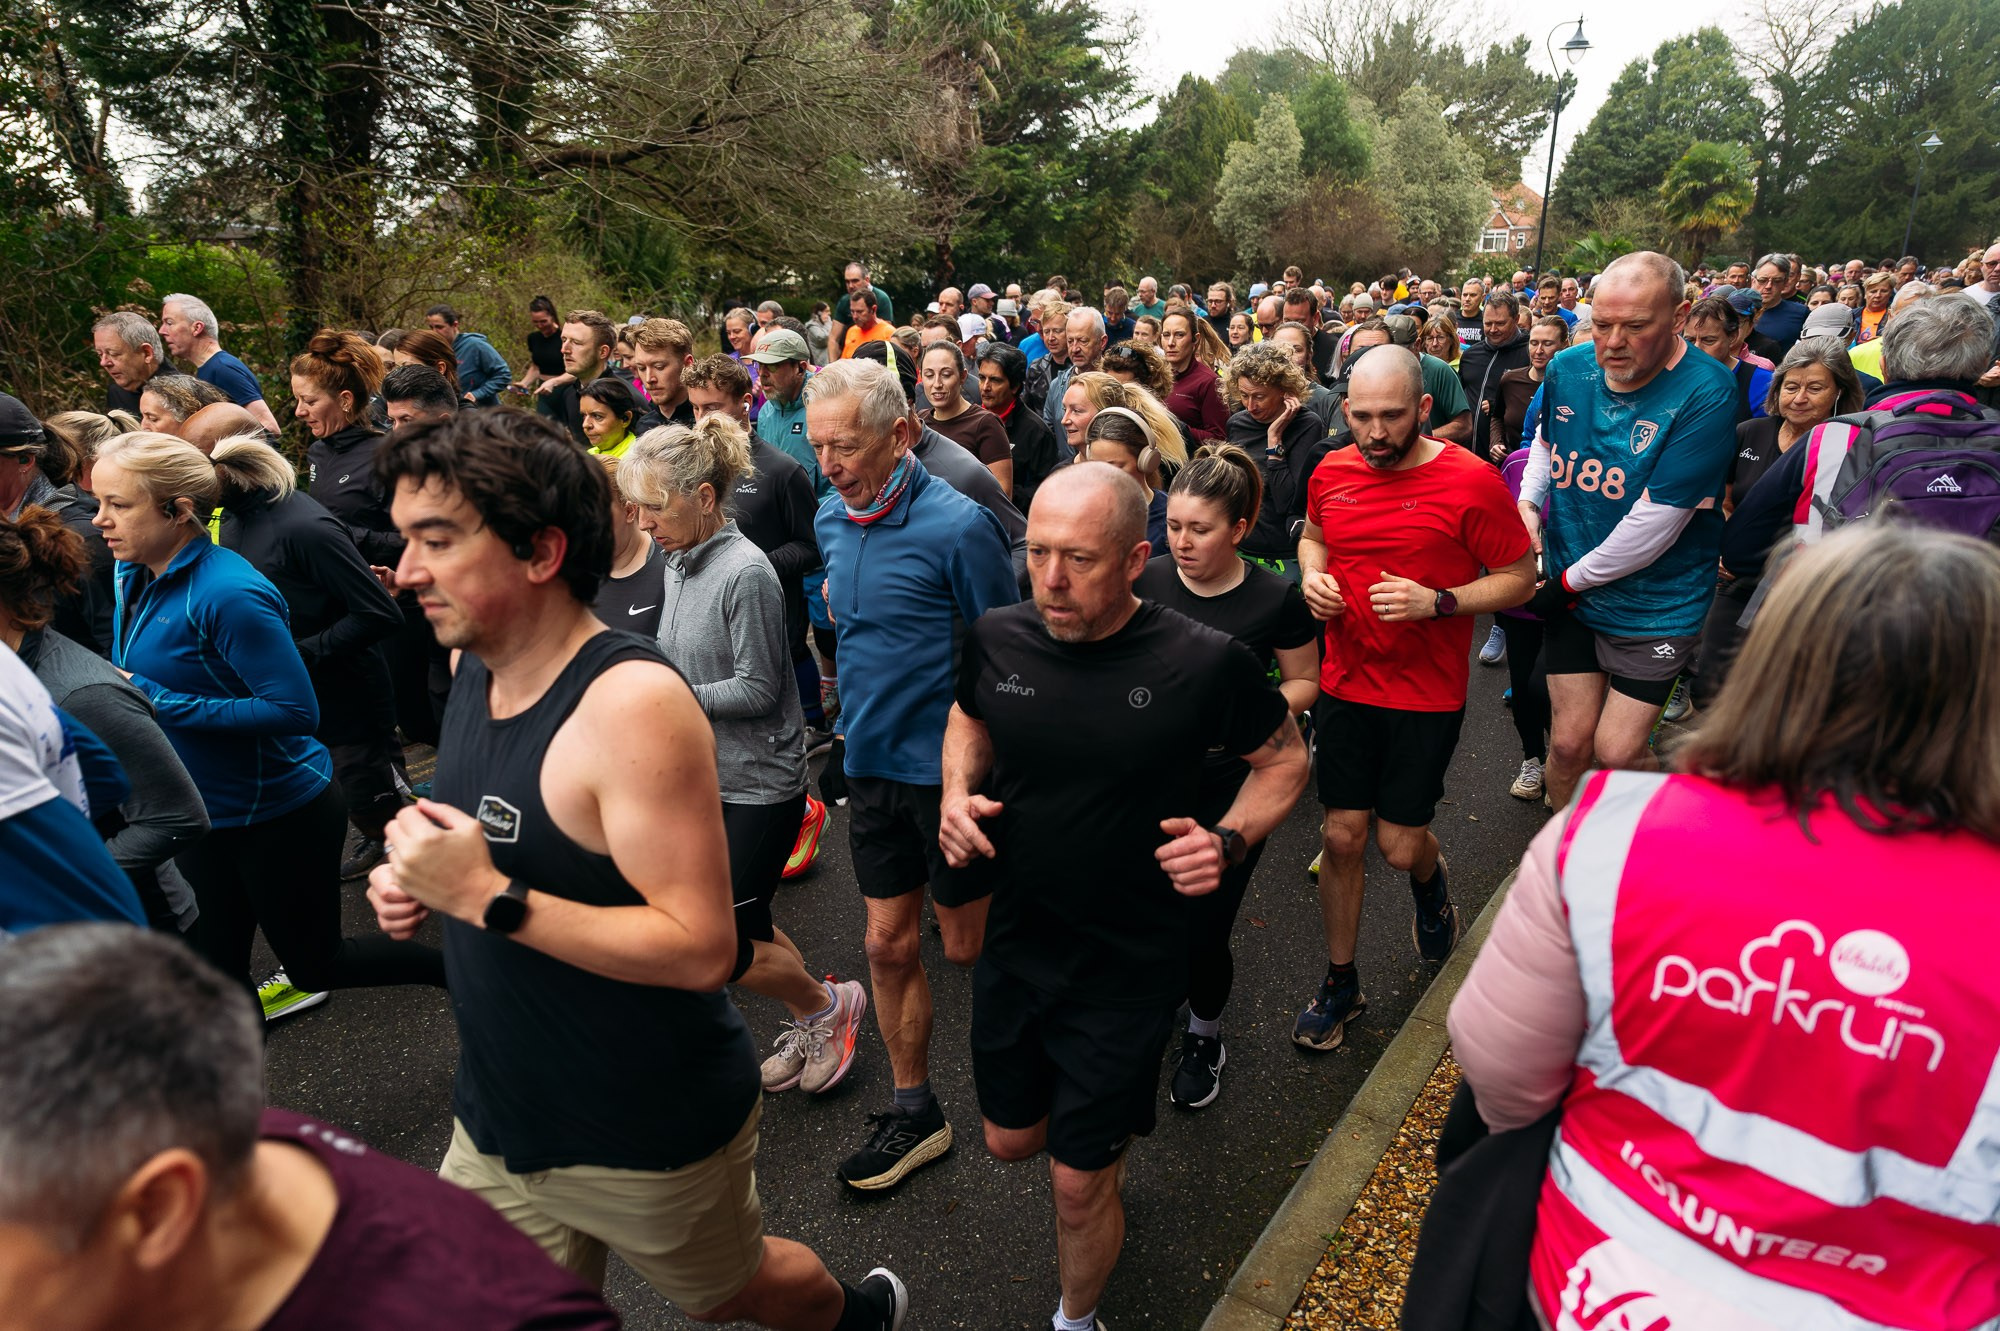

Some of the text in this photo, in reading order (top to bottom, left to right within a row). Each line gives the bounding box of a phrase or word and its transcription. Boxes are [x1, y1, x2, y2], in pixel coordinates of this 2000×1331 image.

[1456, 327, 1482, 335] PROSTATE
[1739, 448, 1760, 461] arkrun
[1550, 443, 1626, 500] bj88
[1927, 485, 1962, 493] KITTER
[995, 674, 1035, 697] parkrun
[1649, 919, 1946, 1072] parkrun
[1619, 1139, 1888, 1277] VOLUNTEER
